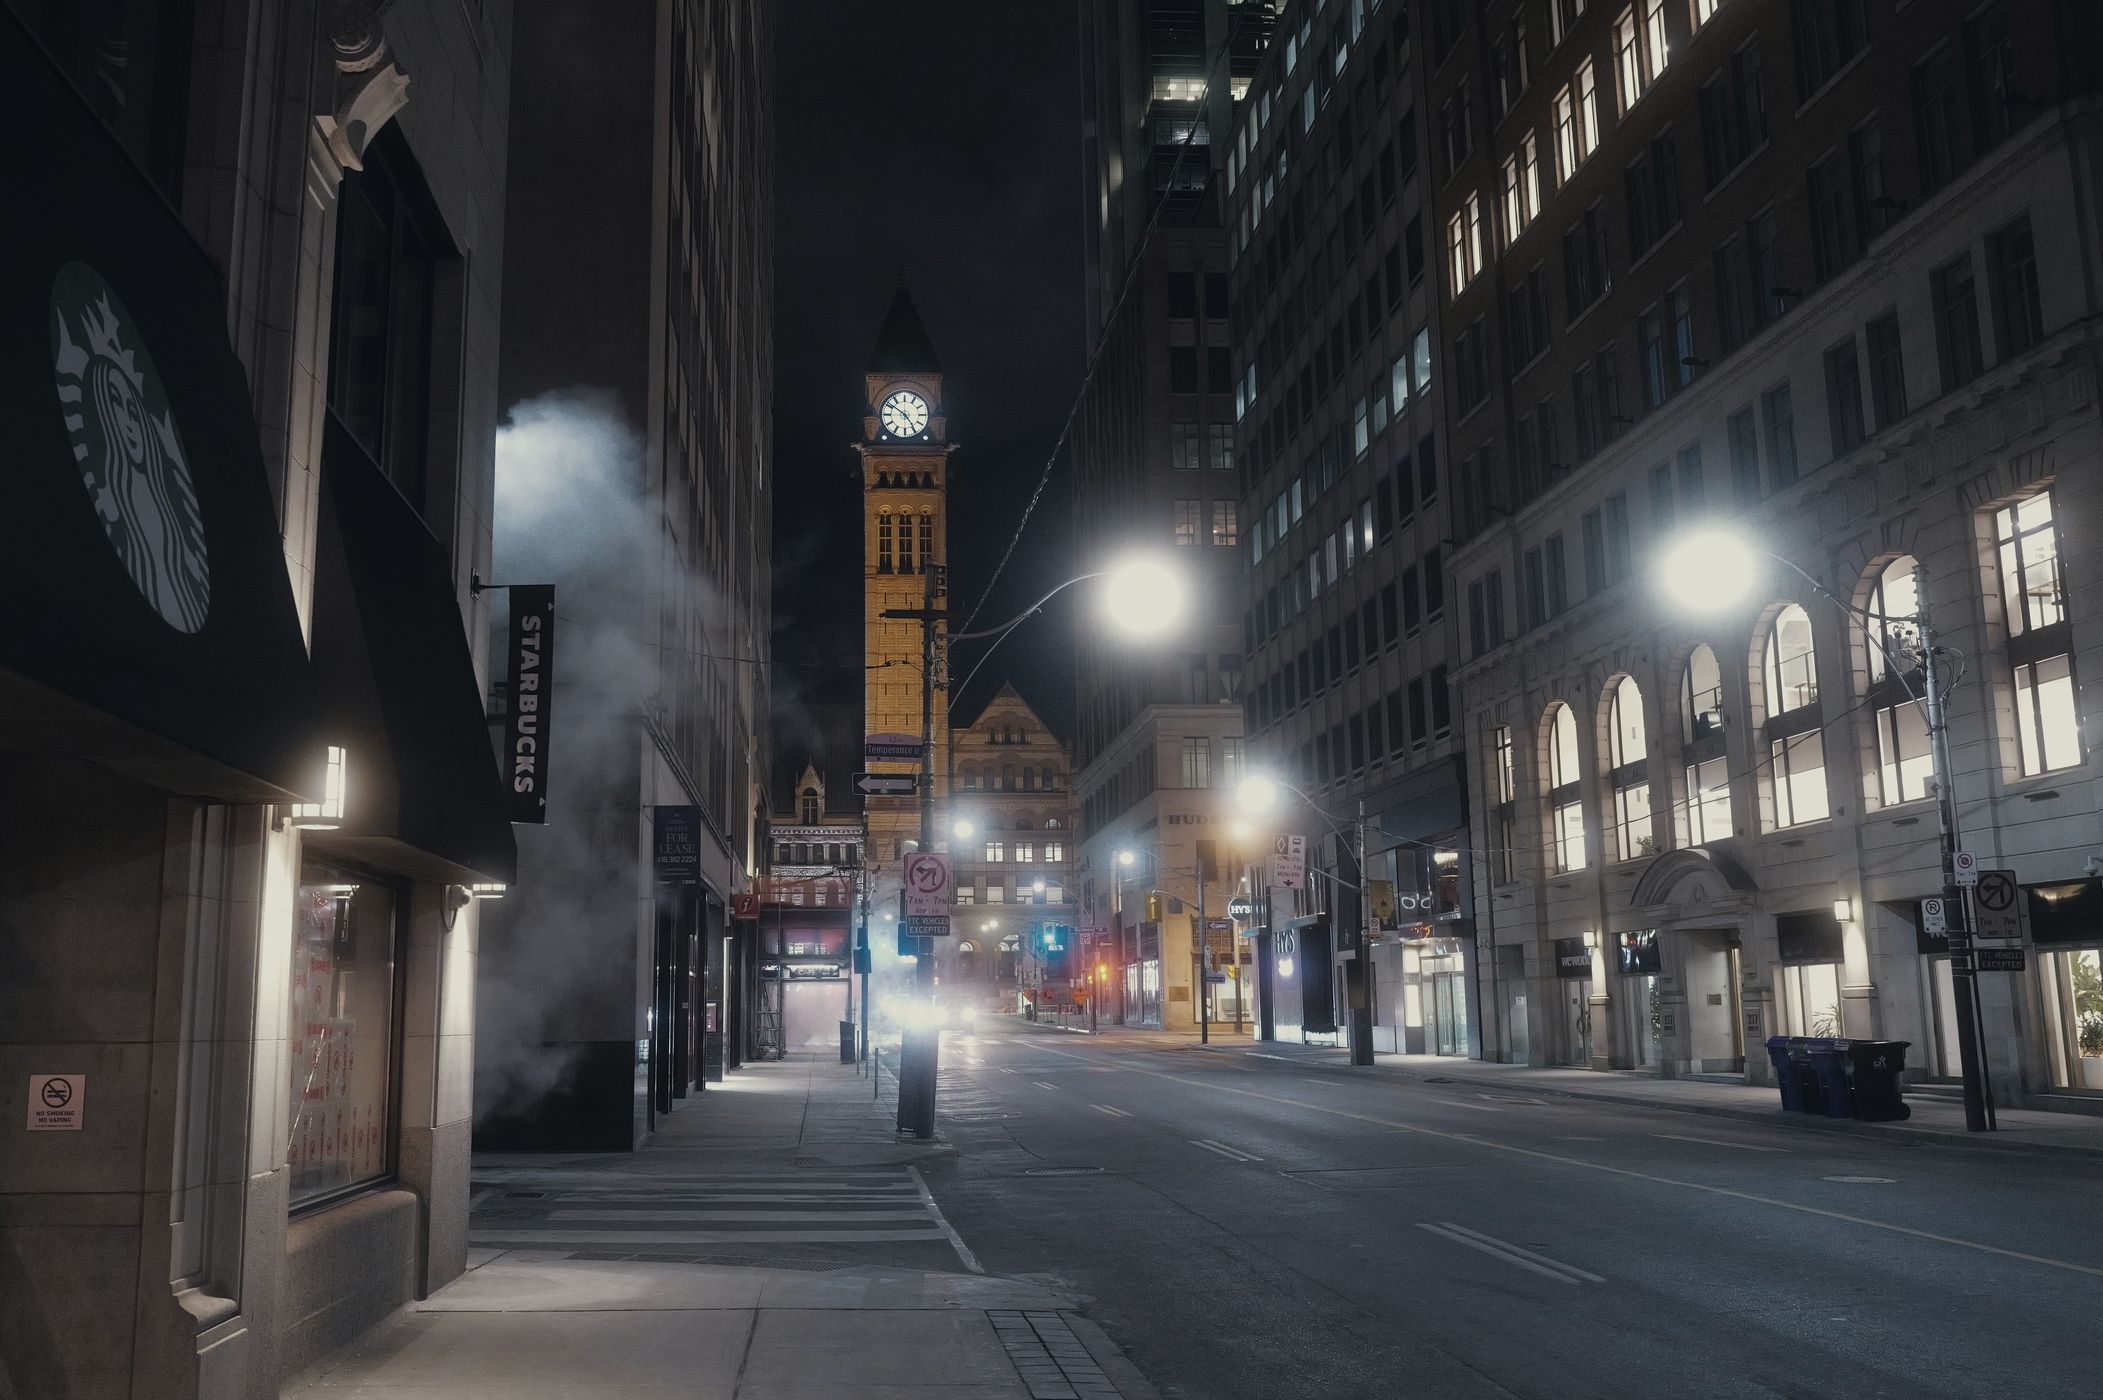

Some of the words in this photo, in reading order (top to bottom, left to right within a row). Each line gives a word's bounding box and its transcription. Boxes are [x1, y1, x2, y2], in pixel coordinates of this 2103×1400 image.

[513, 615, 542, 793] STARBUCKS
[867, 745, 913, 755] Temperance
[666, 832, 688, 842] FOR
[660, 843, 695, 854] LEASE
[908, 895, 924, 904] 7AM
[933, 895, 947, 904] 7PM
[1980, 917, 1992, 926] 7AM
[2004, 917, 2016, 926] 7PM
[909, 926, 947, 934] EXCEPTED
[1994, 951, 2024, 959] VEHICLES
[1982, 960, 2022, 968] EXCEPTED
